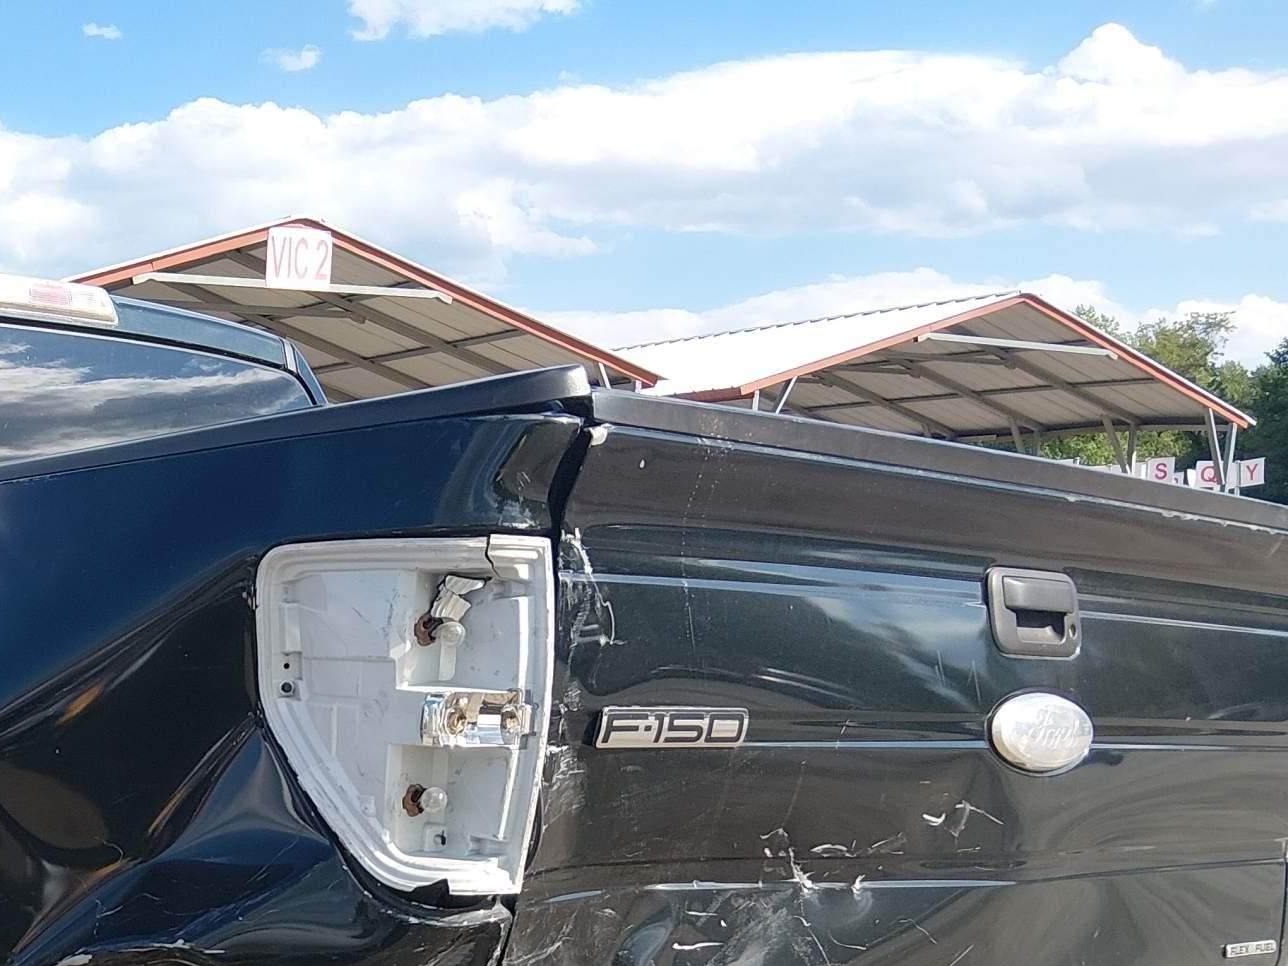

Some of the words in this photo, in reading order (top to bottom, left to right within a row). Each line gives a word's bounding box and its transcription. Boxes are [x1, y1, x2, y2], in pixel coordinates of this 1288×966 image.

[272, 236, 309, 279] VIC
[315, 239, 329, 280] 2
[1154, 463, 1168, 480] S
[1200, 465, 1219, 483] Q
[1246, 464, 1258, 481] Y
[600, 711, 746, 744] F-150
